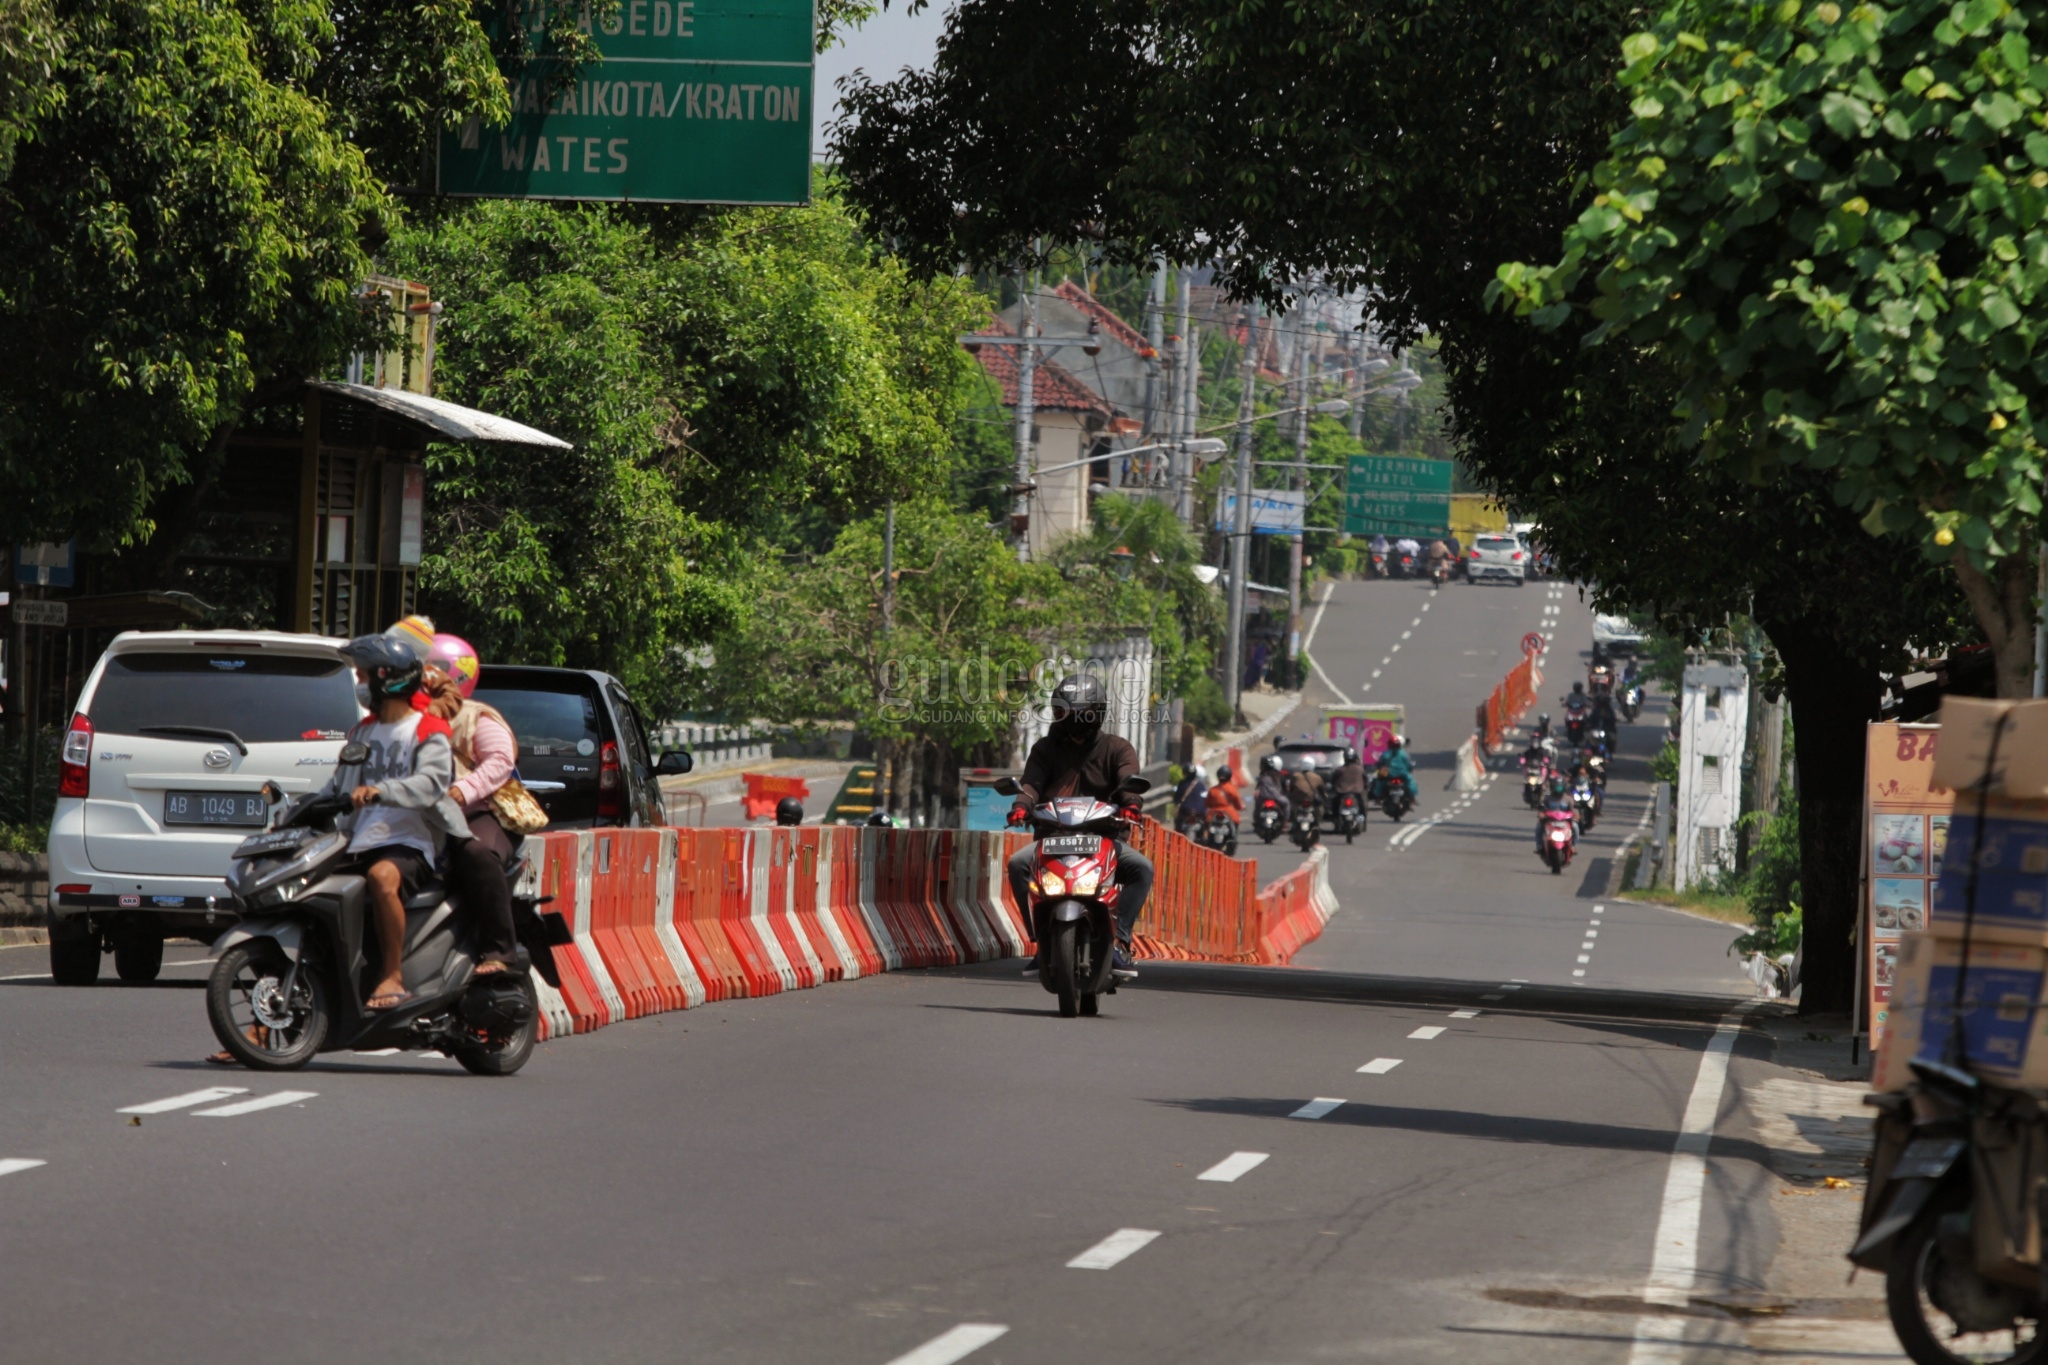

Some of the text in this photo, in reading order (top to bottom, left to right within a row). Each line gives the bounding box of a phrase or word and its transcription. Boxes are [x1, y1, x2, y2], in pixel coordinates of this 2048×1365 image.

[500, 134, 628, 174] WATES
[1364, 503, 1405, 517] WATES
[1897, 732, 1937, 762] BA
[169, 796, 263, 816] AB 1049 BJ
[1044, 838, 1057, 847] AB
[1087, 836, 1099, 845] VY
